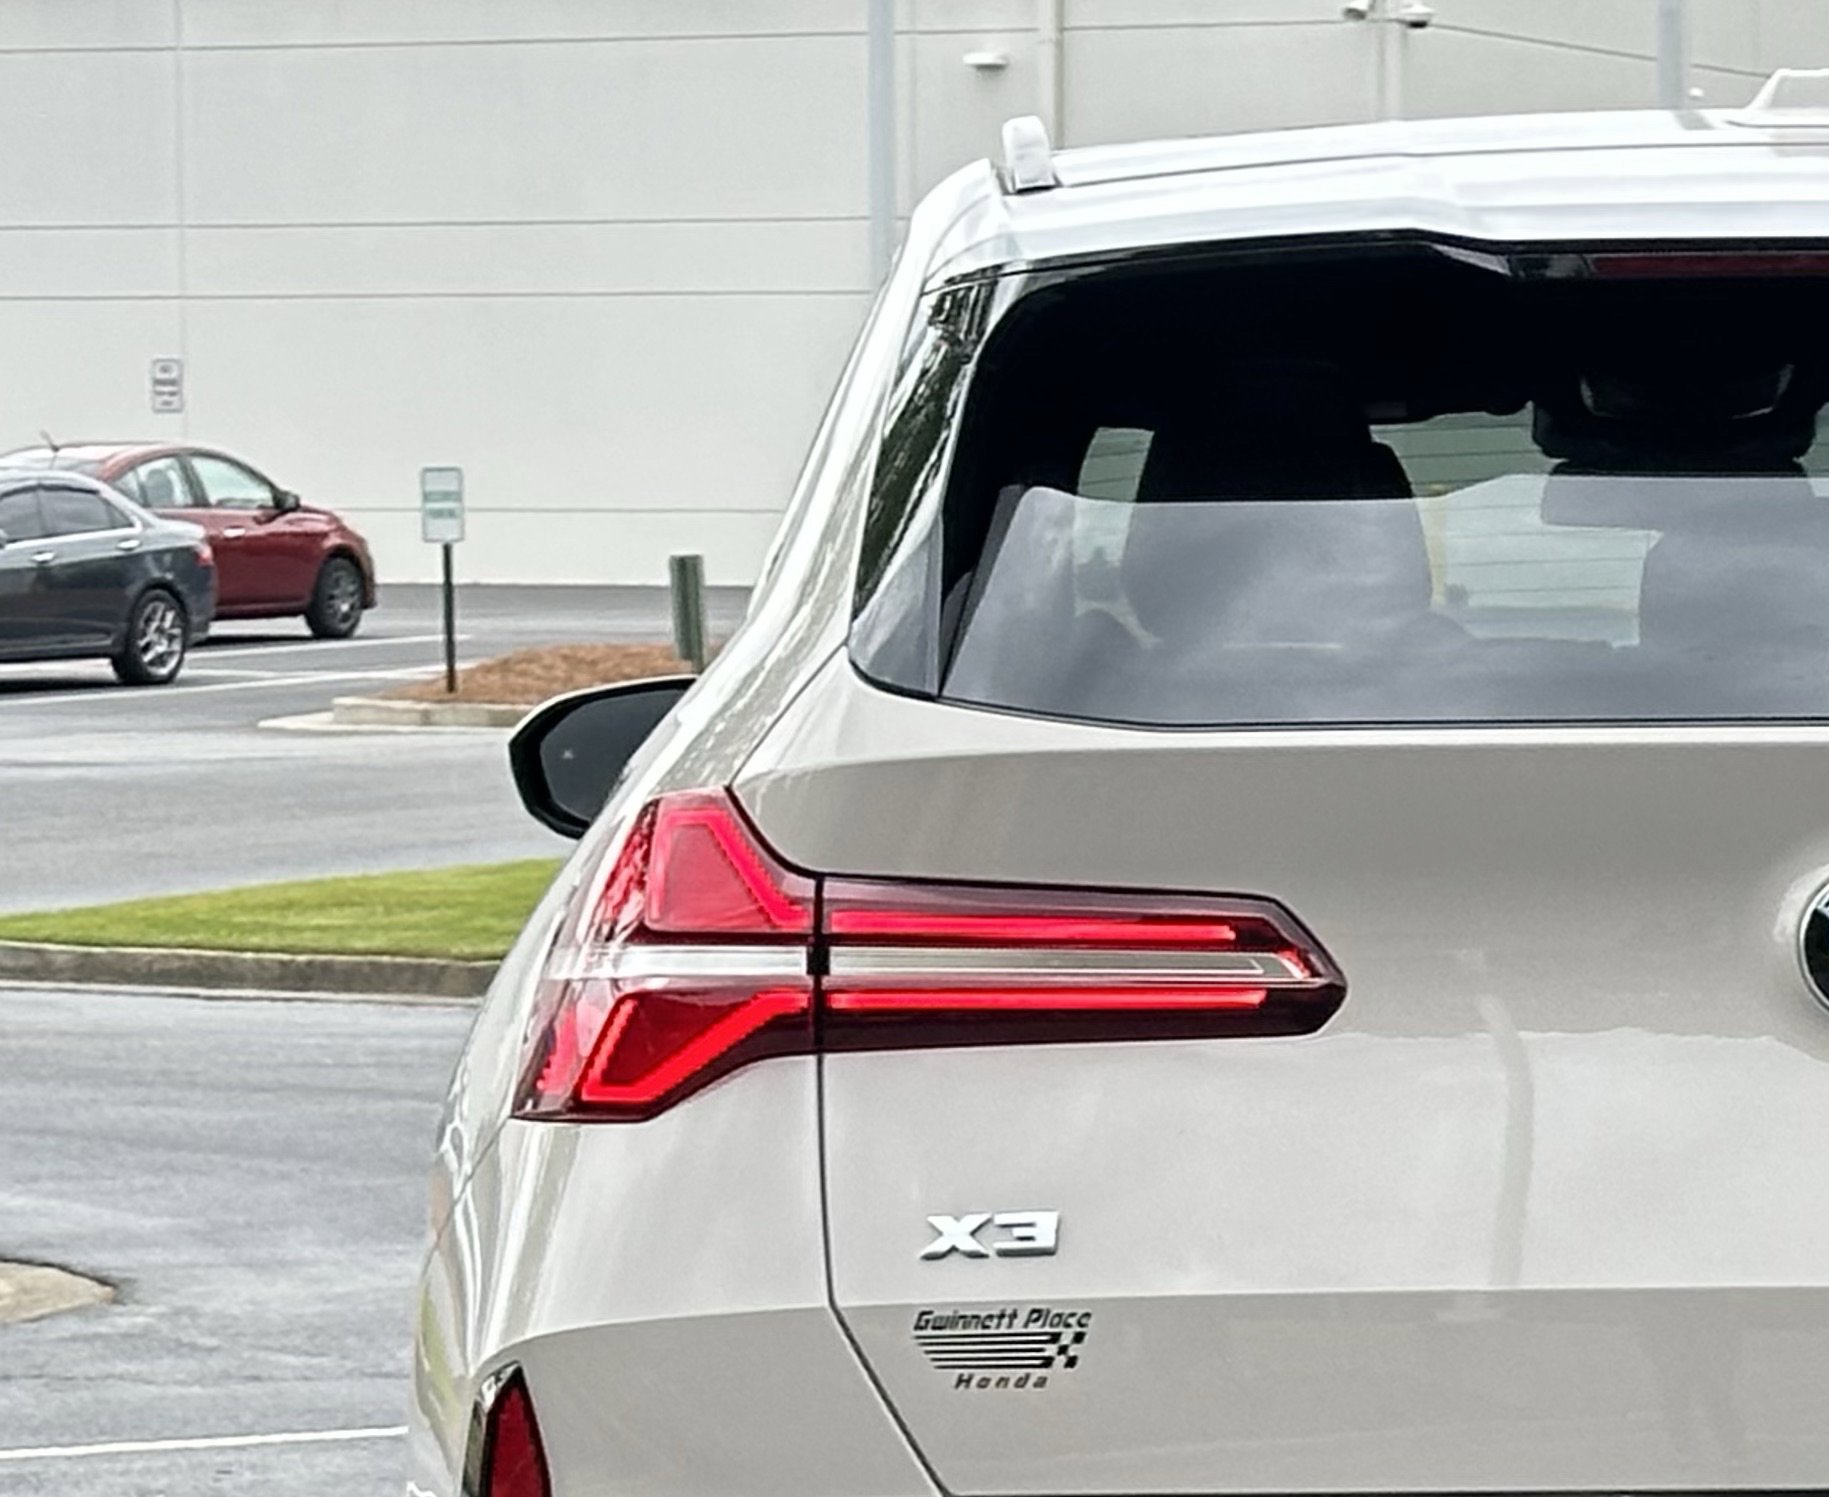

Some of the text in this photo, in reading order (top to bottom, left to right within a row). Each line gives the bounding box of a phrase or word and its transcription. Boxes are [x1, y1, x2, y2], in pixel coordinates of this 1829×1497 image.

[919, 1210, 1060, 1261] X3
[912, 1308, 1092, 1332] Gwinnett Place
[953, 1373, 1049, 1390] Honda
